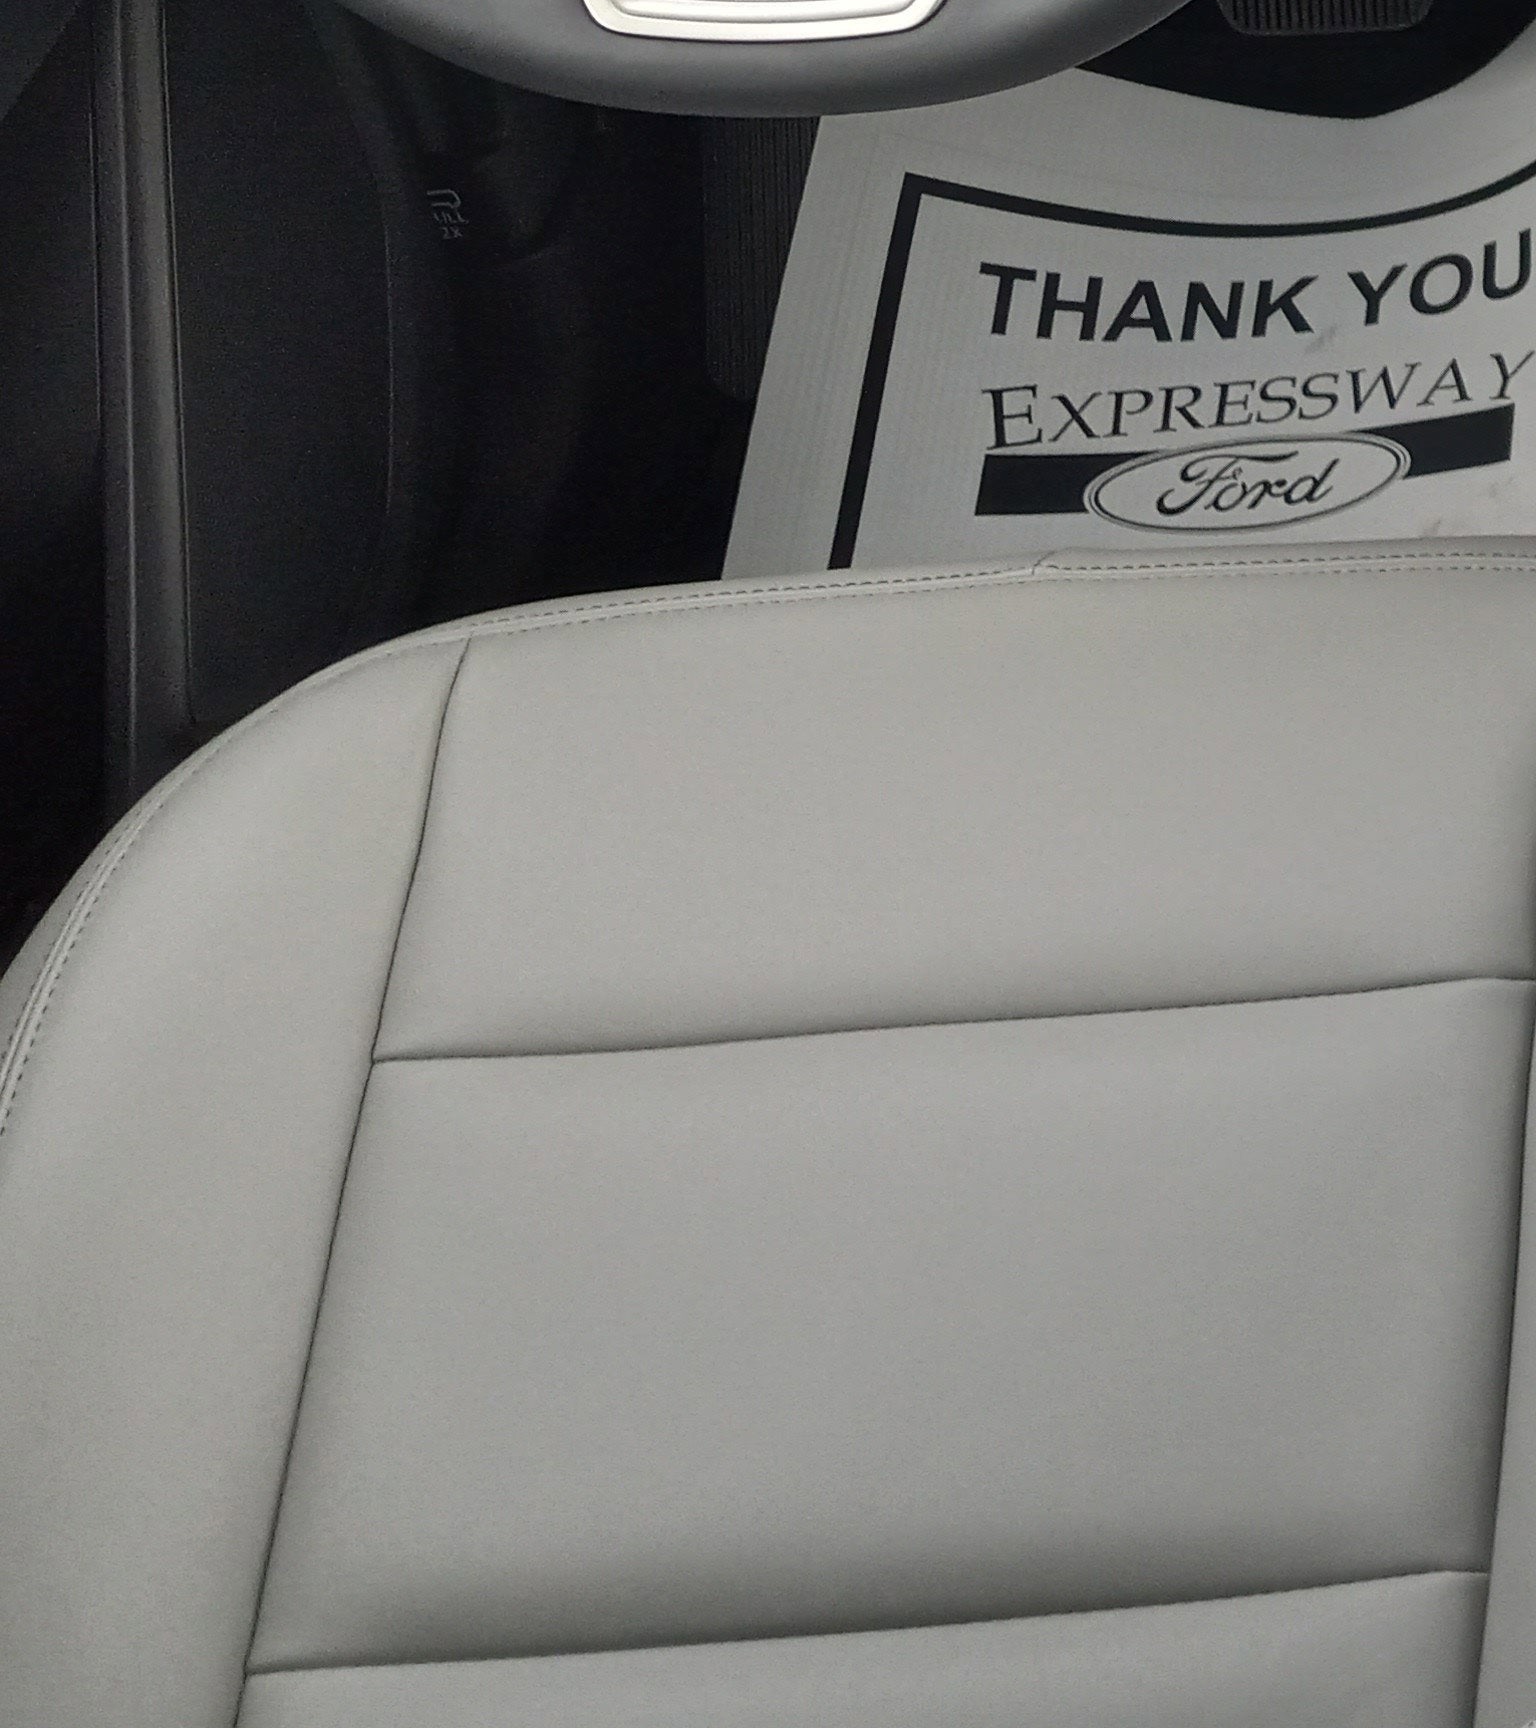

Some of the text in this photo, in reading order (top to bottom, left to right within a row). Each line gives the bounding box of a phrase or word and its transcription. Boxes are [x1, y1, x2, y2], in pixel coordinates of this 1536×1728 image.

[979, 261, 1320, 343] THANK
[980, 350, 1535, 451] EXPRESSWAY
[1154, 451, 1336, 519] Ford
